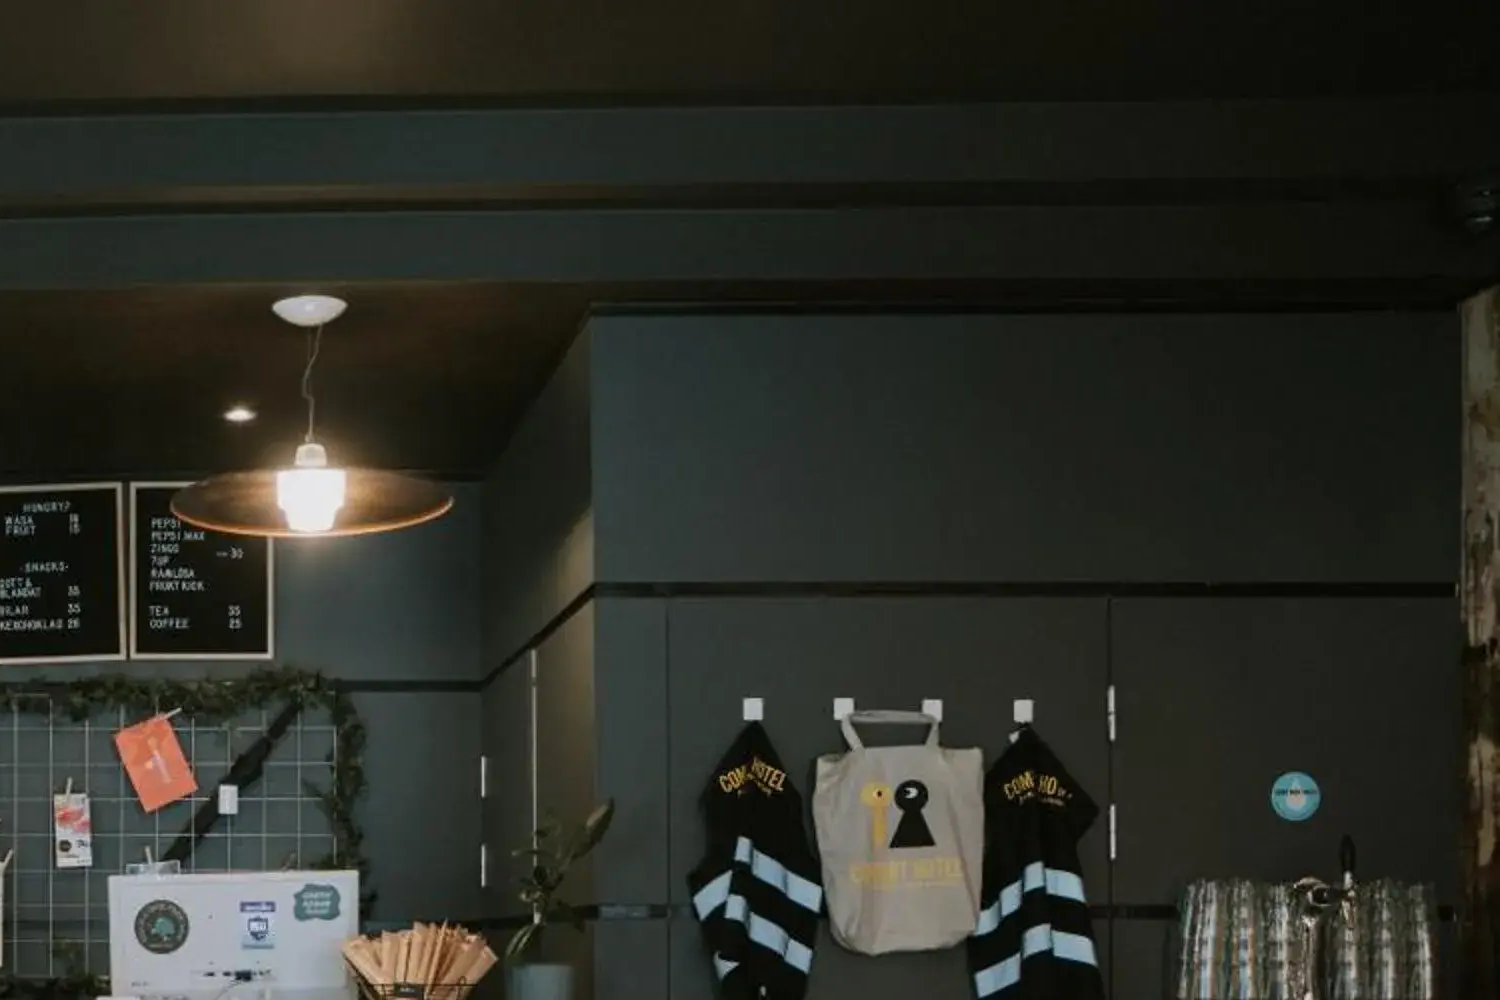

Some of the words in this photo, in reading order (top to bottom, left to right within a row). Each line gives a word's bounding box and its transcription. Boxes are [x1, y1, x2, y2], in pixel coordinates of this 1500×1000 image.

[151, 517, 182, 529] PEPSI
[151, 531, 182, 542] PEPSI
[149, 605, 170, 617] TEA
[149, 618, 190, 630] COFFEE
